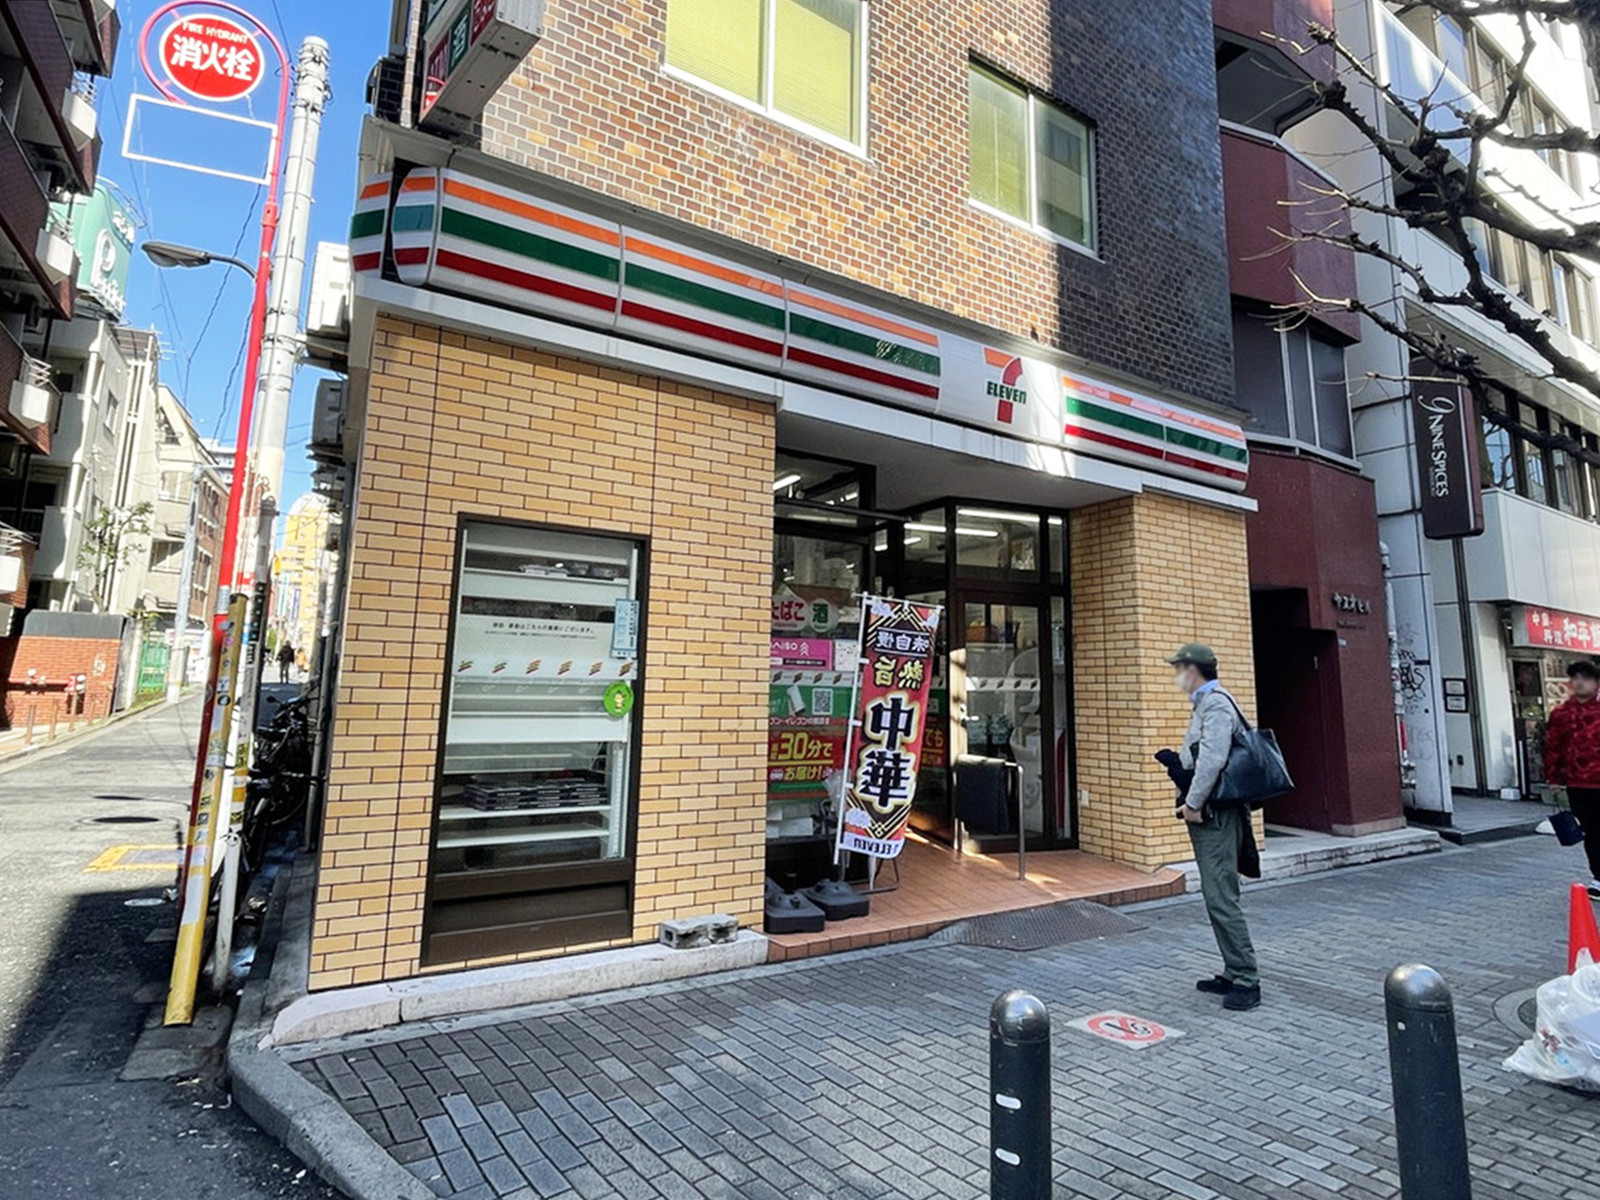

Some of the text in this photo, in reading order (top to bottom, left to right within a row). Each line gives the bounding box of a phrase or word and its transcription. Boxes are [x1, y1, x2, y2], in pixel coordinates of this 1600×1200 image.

[182, 22, 248, 44] FIRE HYDRANT
[170, 34, 255, 81] 消火栓
[812, 603, 828, 623] 酒
